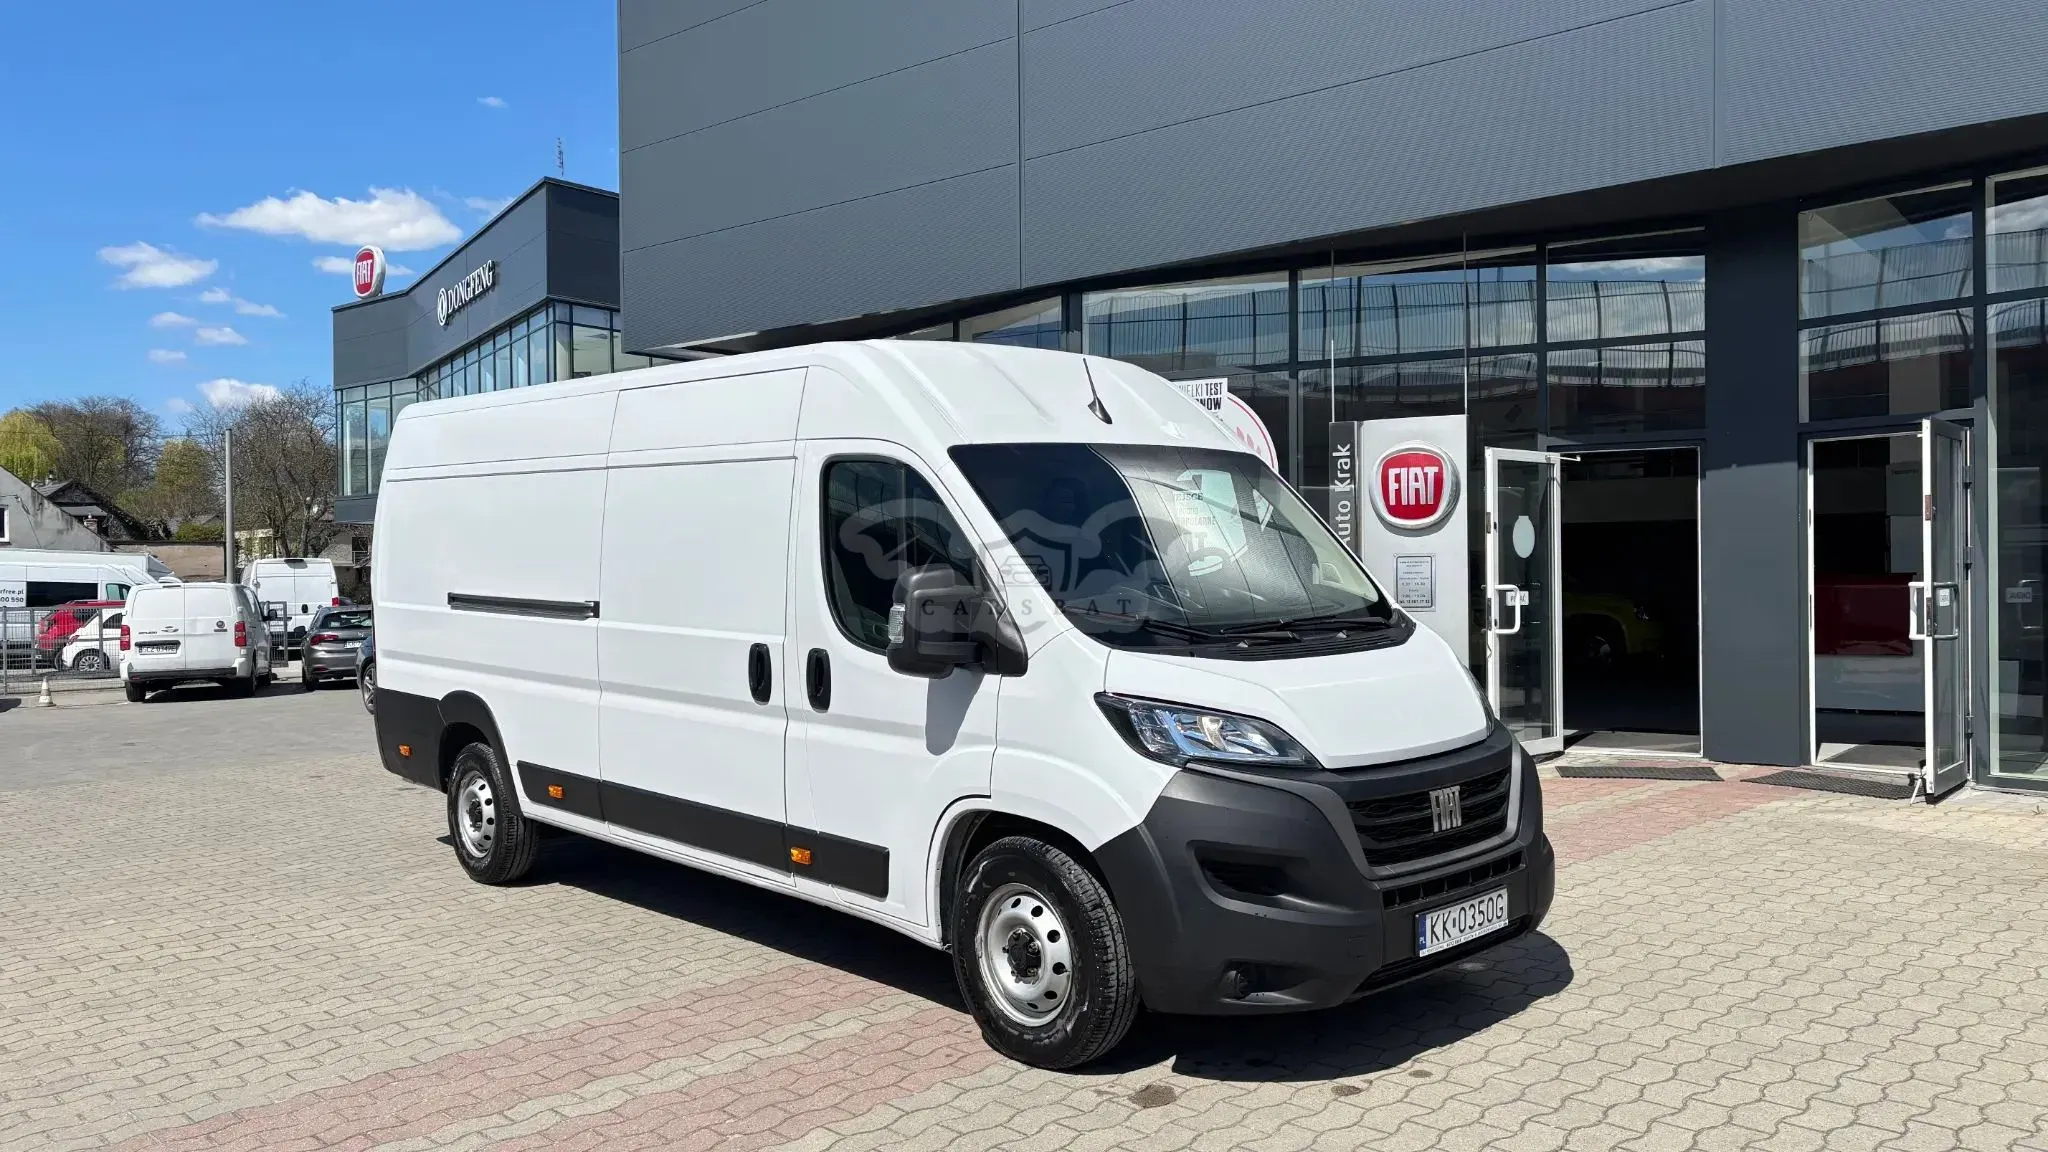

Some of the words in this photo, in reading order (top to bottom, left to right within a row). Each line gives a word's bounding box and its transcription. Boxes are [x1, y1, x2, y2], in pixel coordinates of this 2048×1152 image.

[356, 259, 373, 286] FIAT
[447, 260, 494, 313] DONGFENG
[1205, 382, 1223, 396] TEST
[1332, 443, 1351, 493] Krak
[1388, 466, 1439, 506] FIAT
[1429, 785, 1463, 833] FIAT
